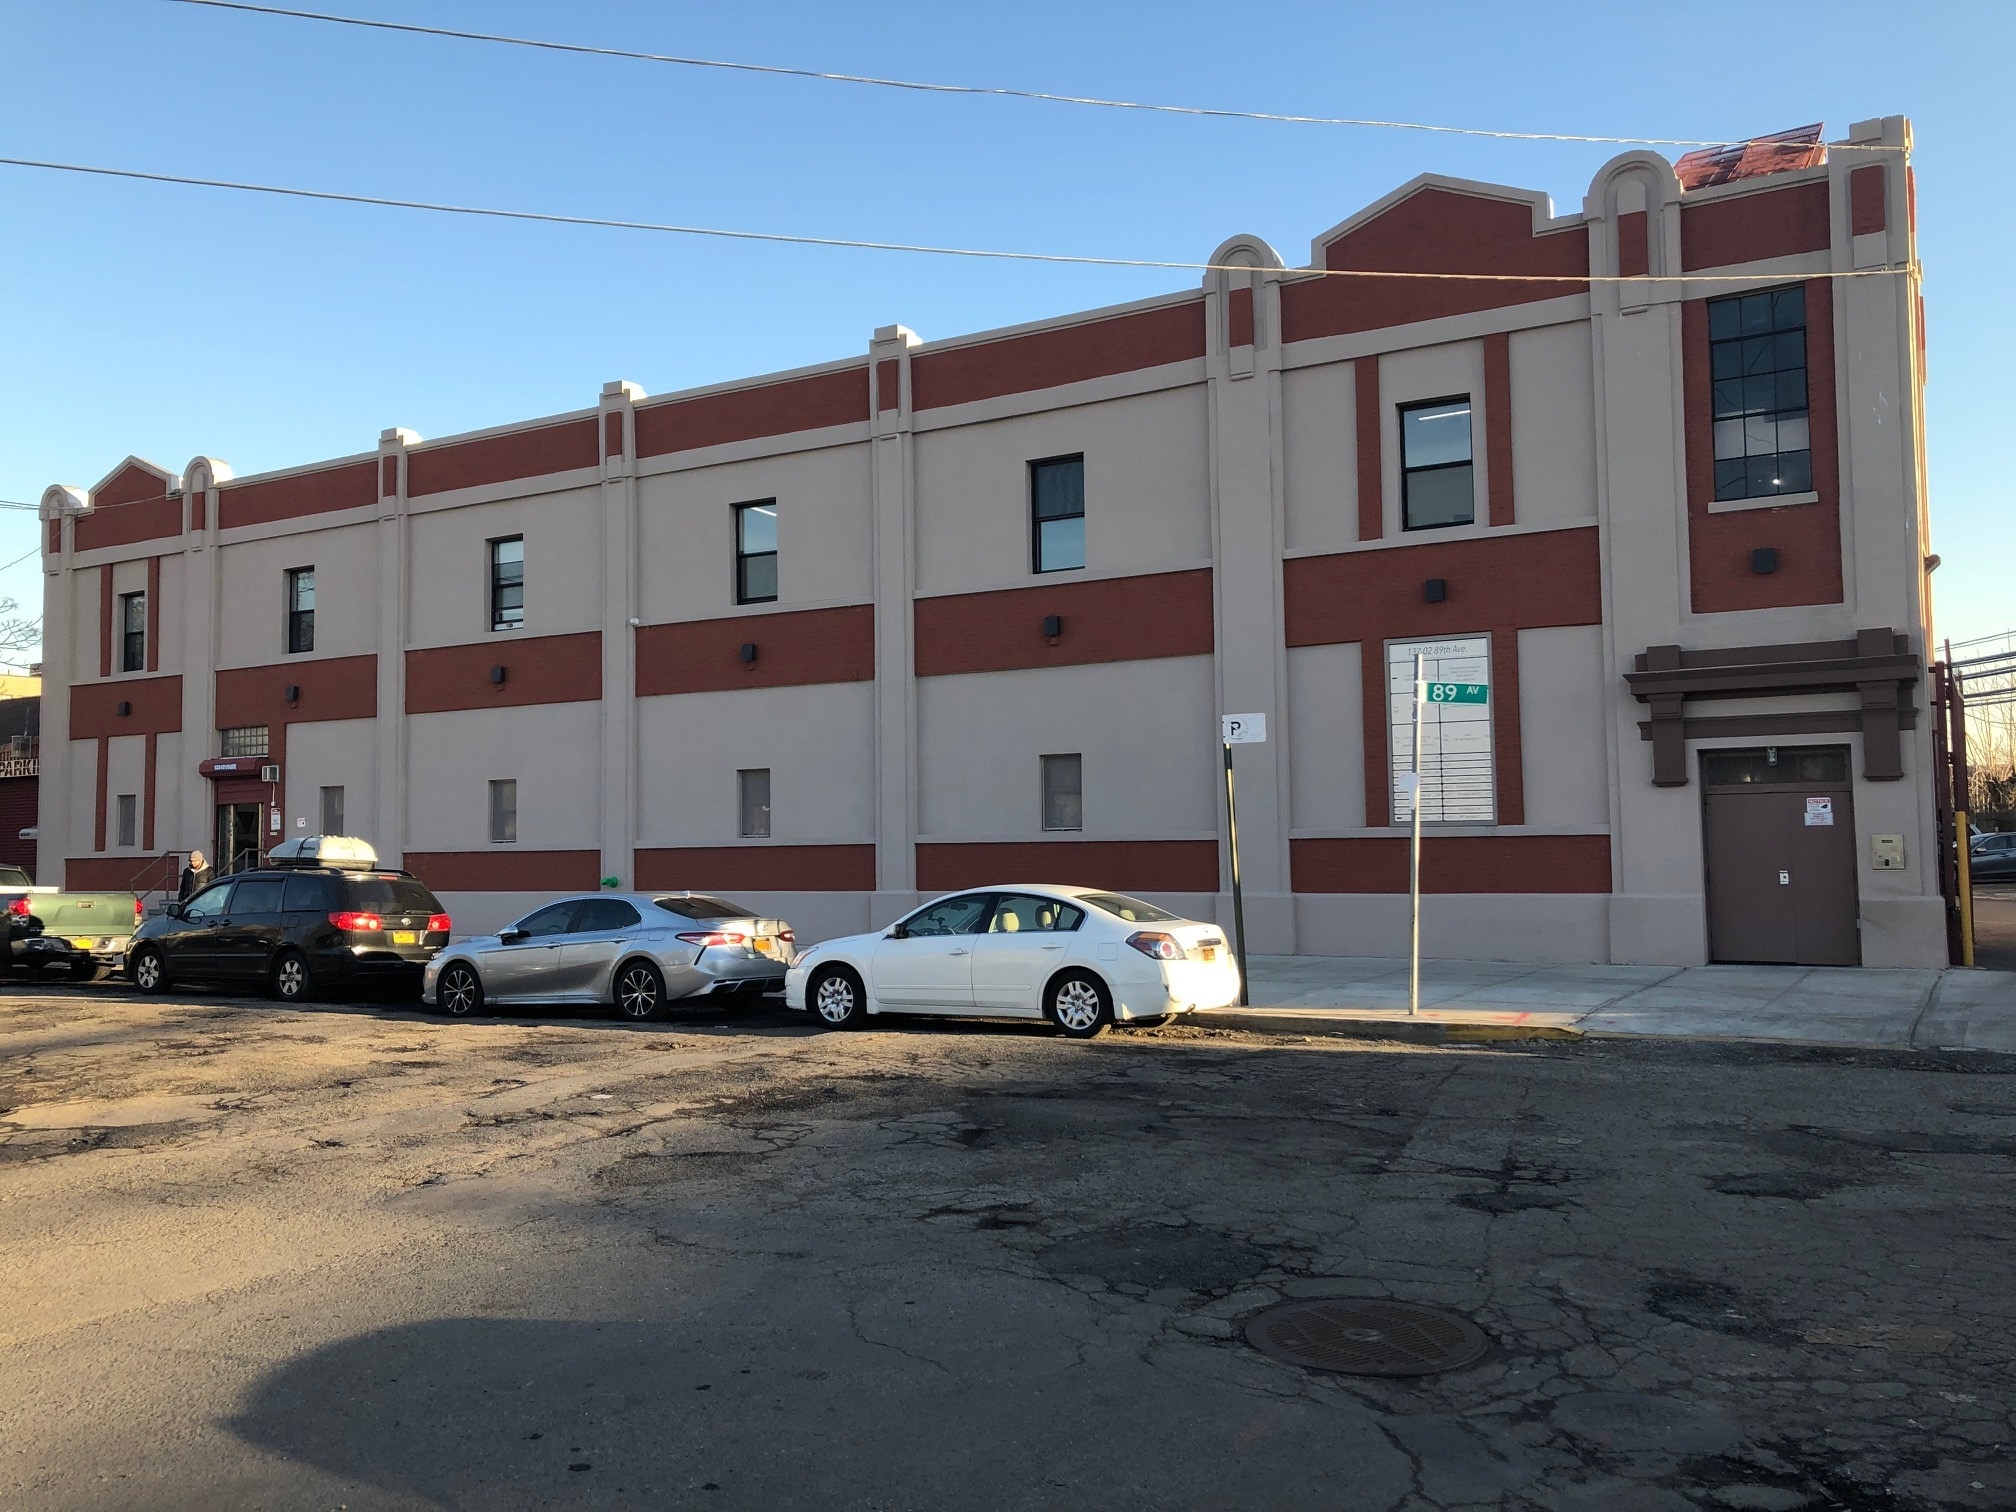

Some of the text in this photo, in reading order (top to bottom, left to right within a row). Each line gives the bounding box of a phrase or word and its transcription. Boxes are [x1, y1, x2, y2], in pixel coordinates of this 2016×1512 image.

[1433, 645, 1451, 654] 89th
[1432, 684, 1480, 701] 89 AV
[0, 759, 39, 777] PARKI
